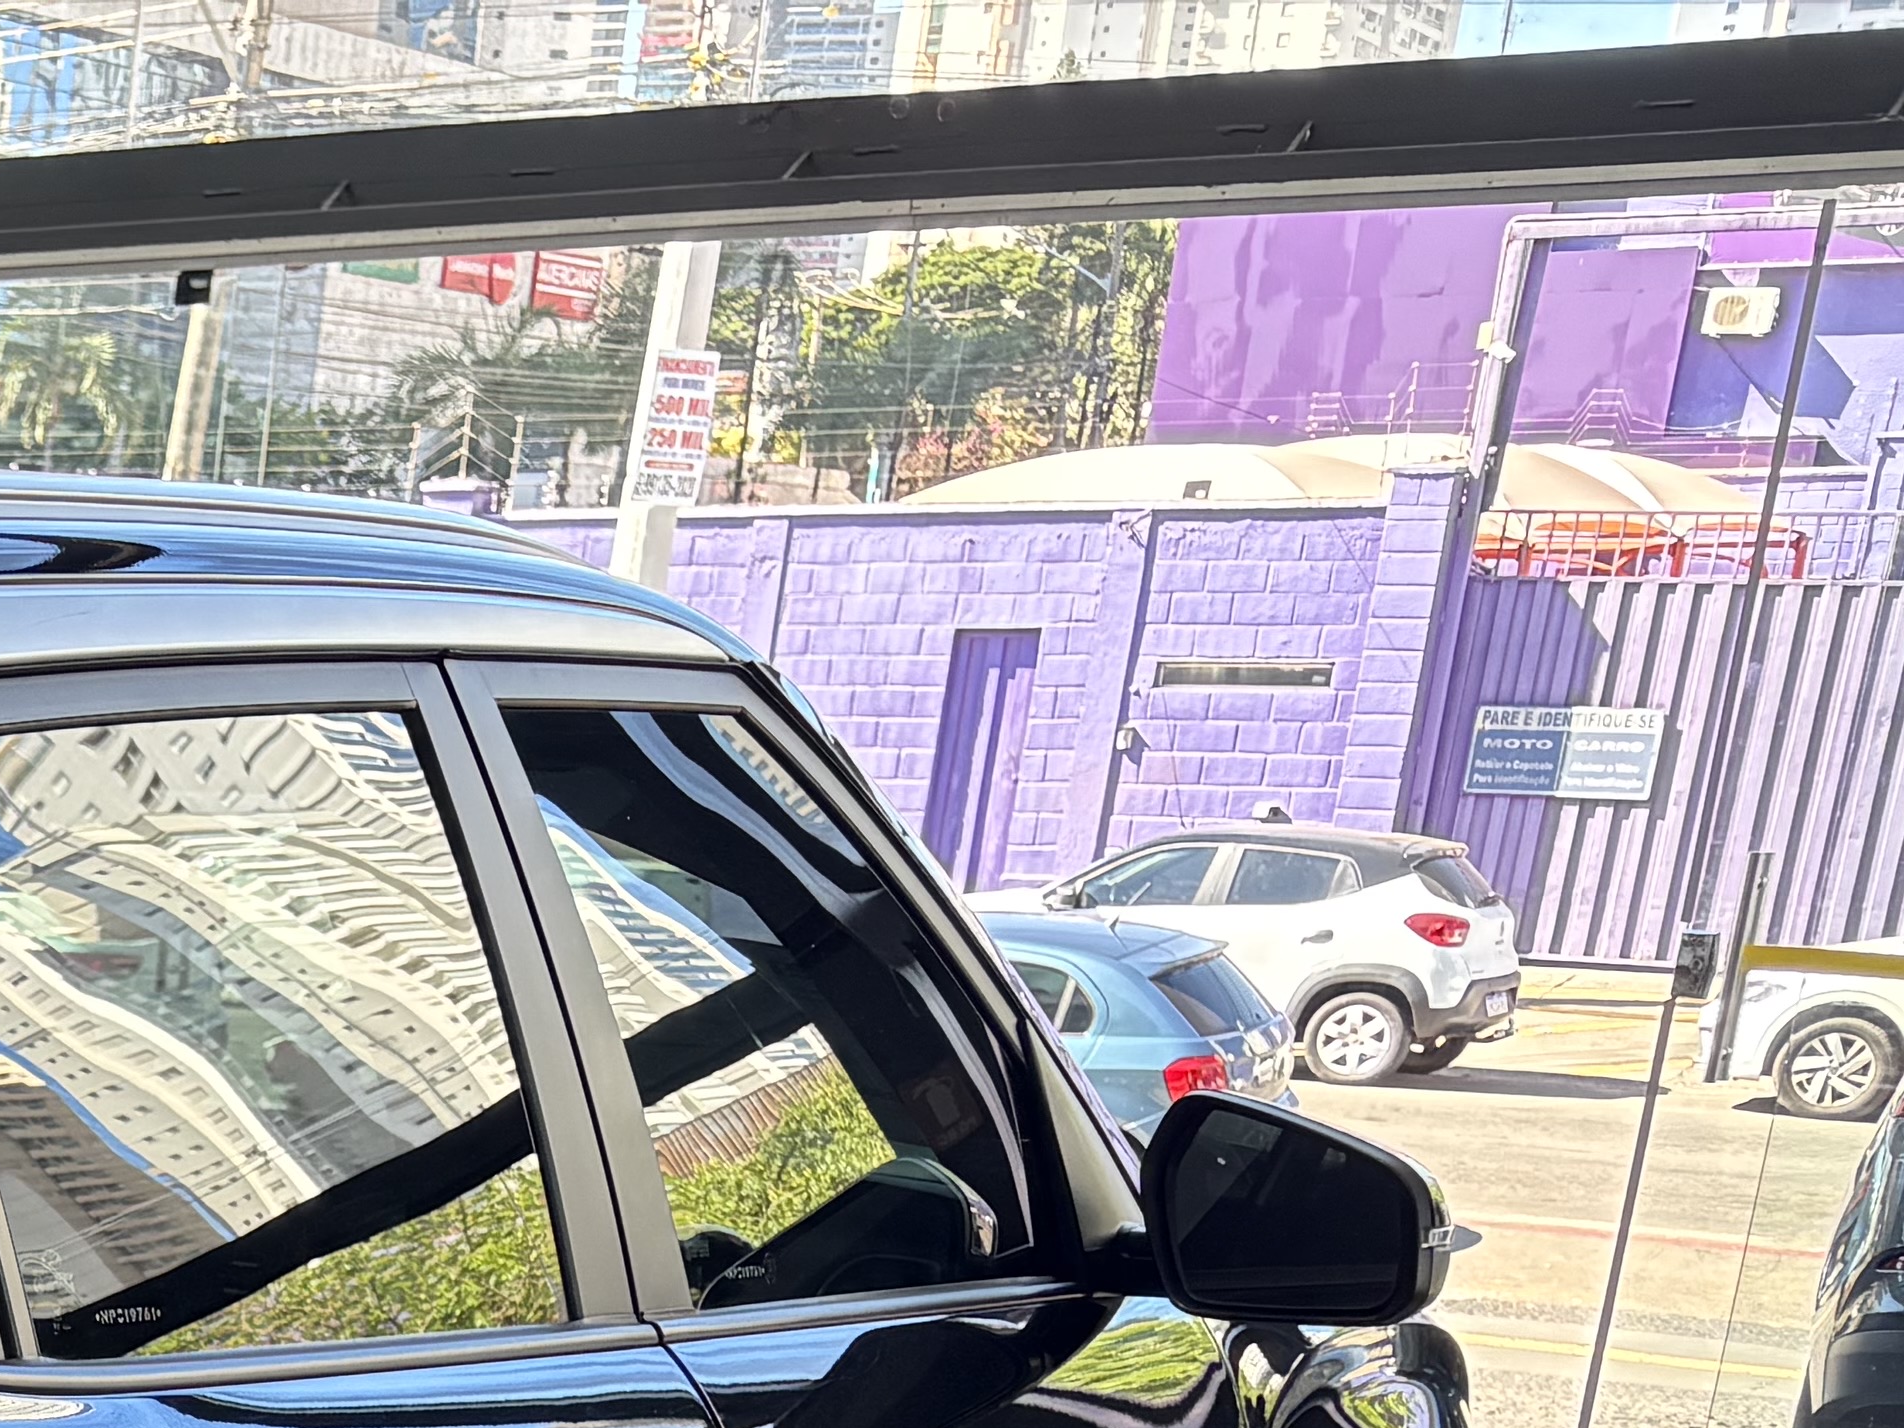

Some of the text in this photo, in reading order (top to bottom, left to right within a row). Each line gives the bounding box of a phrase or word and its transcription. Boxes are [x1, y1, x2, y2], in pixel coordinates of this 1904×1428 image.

[1482, 710, 1521, 727] PARE
[1523, 710, 1534, 726] E
[1483, 737, 1554, 750] MOTO
[1573, 739, 1646, 753] CARRO
